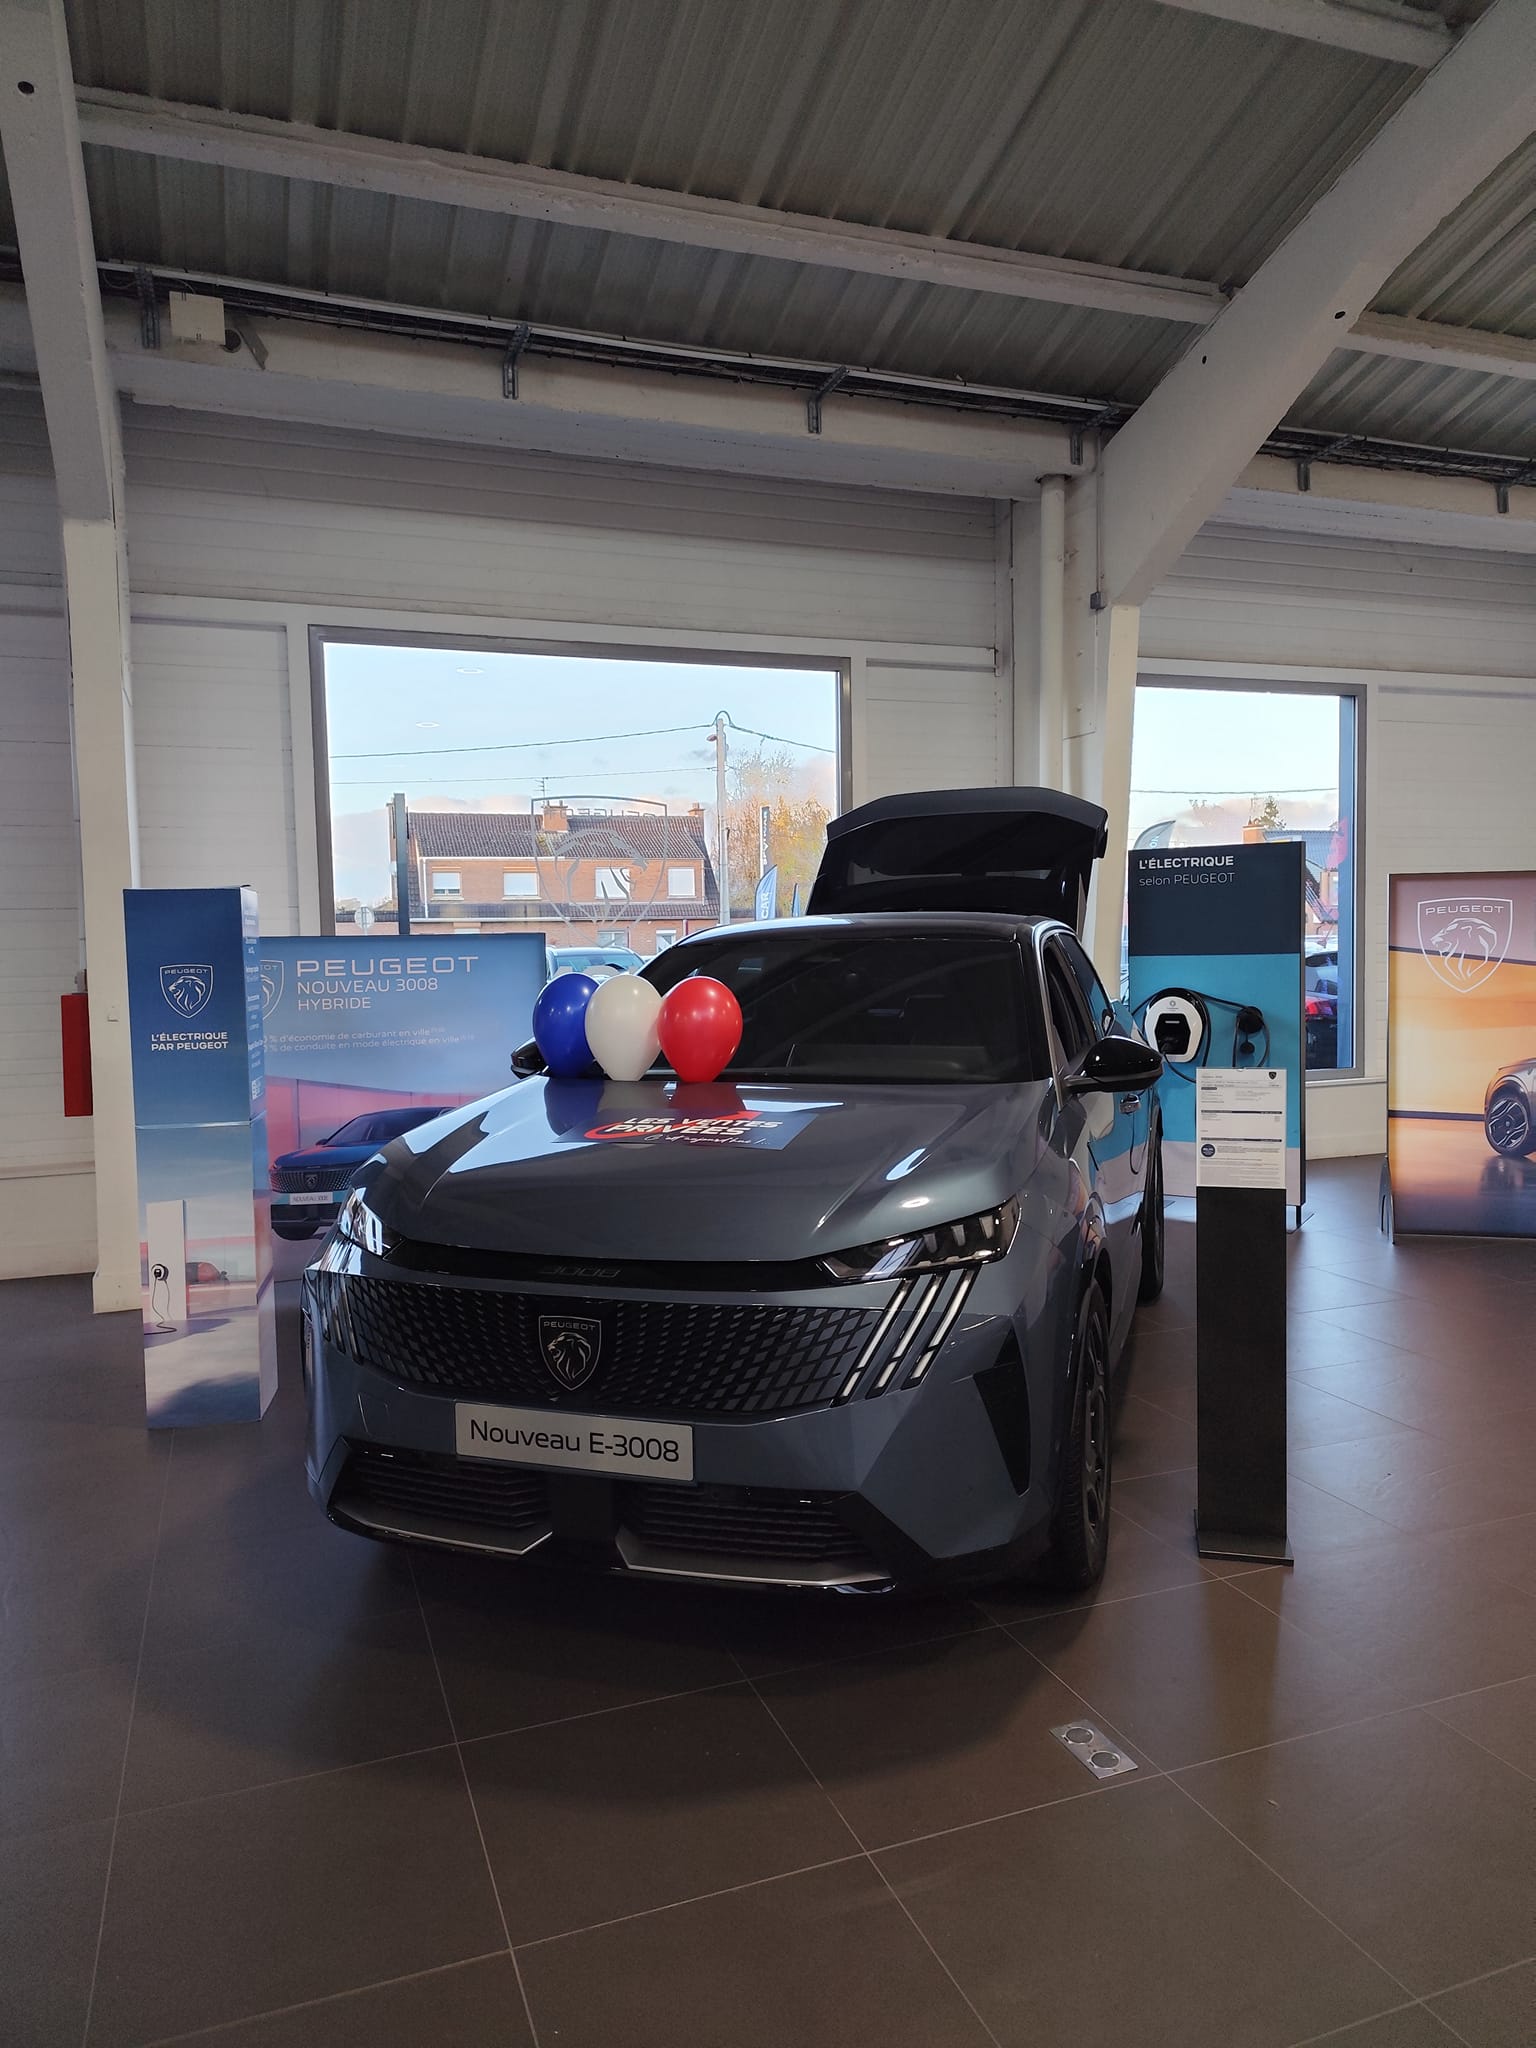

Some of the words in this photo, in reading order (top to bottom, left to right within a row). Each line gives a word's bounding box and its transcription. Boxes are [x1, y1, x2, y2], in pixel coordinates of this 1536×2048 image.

[1139, 856, 1234, 869] L'ÉLECTRIQUE
[1139, 876, 1170, 886] selon
[1174, 872, 1235, 884] PEUGEOT
[1425, 905, 1504, 915] PEUGEOT
[296, 956, 479, 977] PEUGEOT
[297, 980, 390, 995] NOUVEAU
[396, 977, 438, 992] 3008
[298, 997, 371, 1011] HYBRIDE
[151, 1032, 228, 1042] L'ÉLECTRIQUE
[279, 1033, 335, 1043] d'économie
[337, 1032, 349, 1041] de
[351, 1030, 398, 1039] carburant
[151, 1043, 174, 1051] PAR
[177, 1041, 229, 1050] PEUGEOT
[279, 1042, 292, 1051] de
[294, 1041, 336, 1051] conduite
[352, 1039, 379, 1048] mode
[382, 1038, 426, 1048] électrique
[624, 1117, 675, 1125] LES
[681, 1118, 784, 1129] VENTES
[543, 1321, 596, 1331] PEUGEOT
[470, 1419, 581, 1452] Nouveau
[589, 1432, 680, 1463] E-3008
